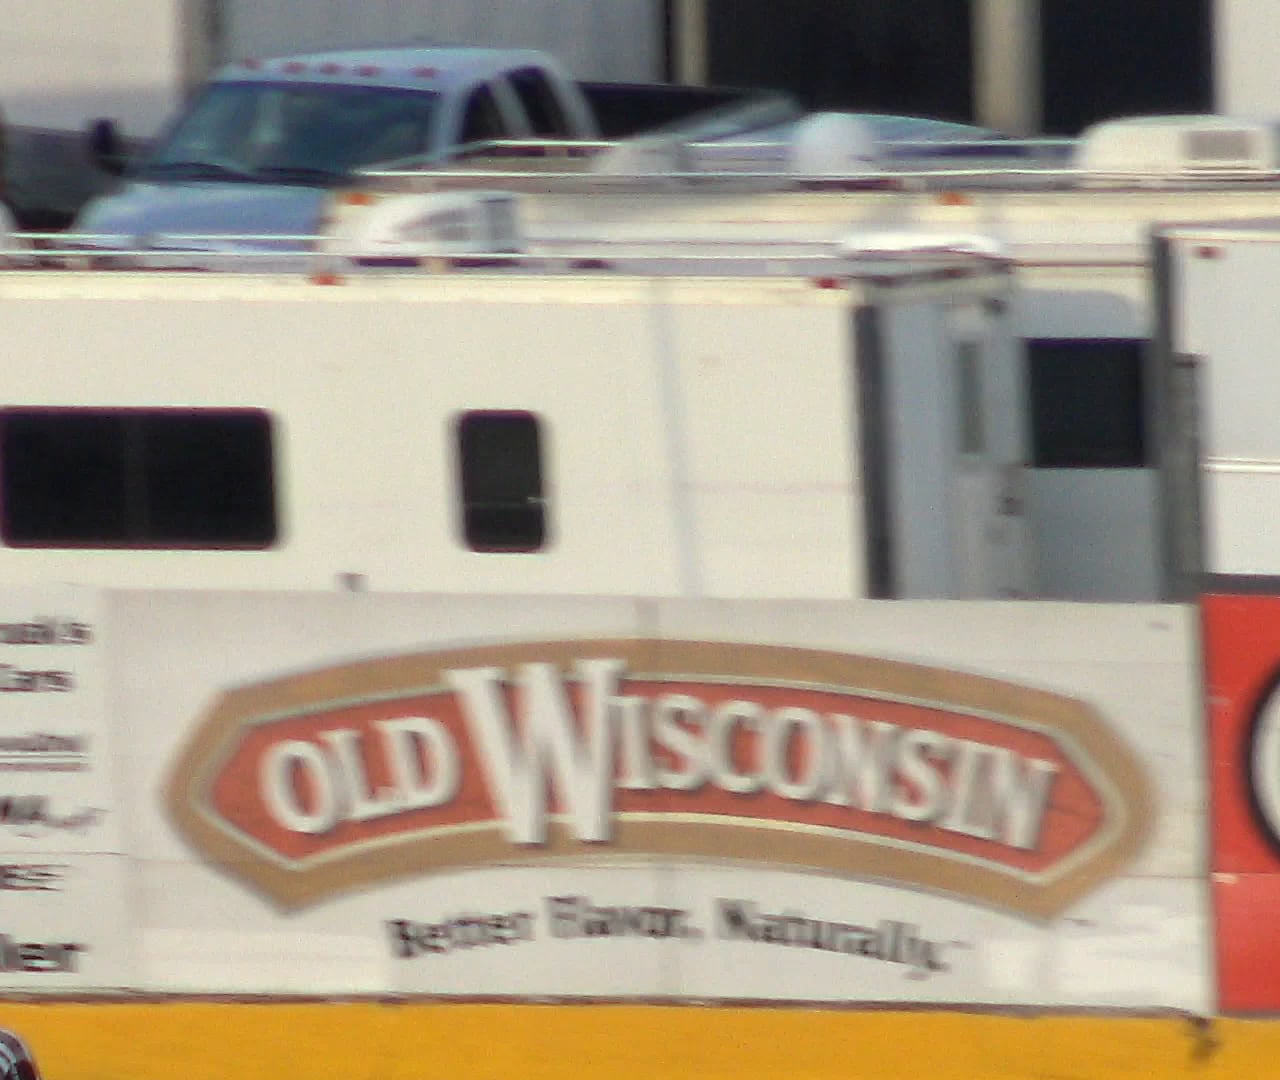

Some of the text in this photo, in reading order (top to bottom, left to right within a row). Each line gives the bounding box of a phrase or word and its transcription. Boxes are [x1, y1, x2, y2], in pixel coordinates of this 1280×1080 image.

[260, 657, 1057, 852] OLD WISCONSIN
[383, 911, 535, 960] Better
